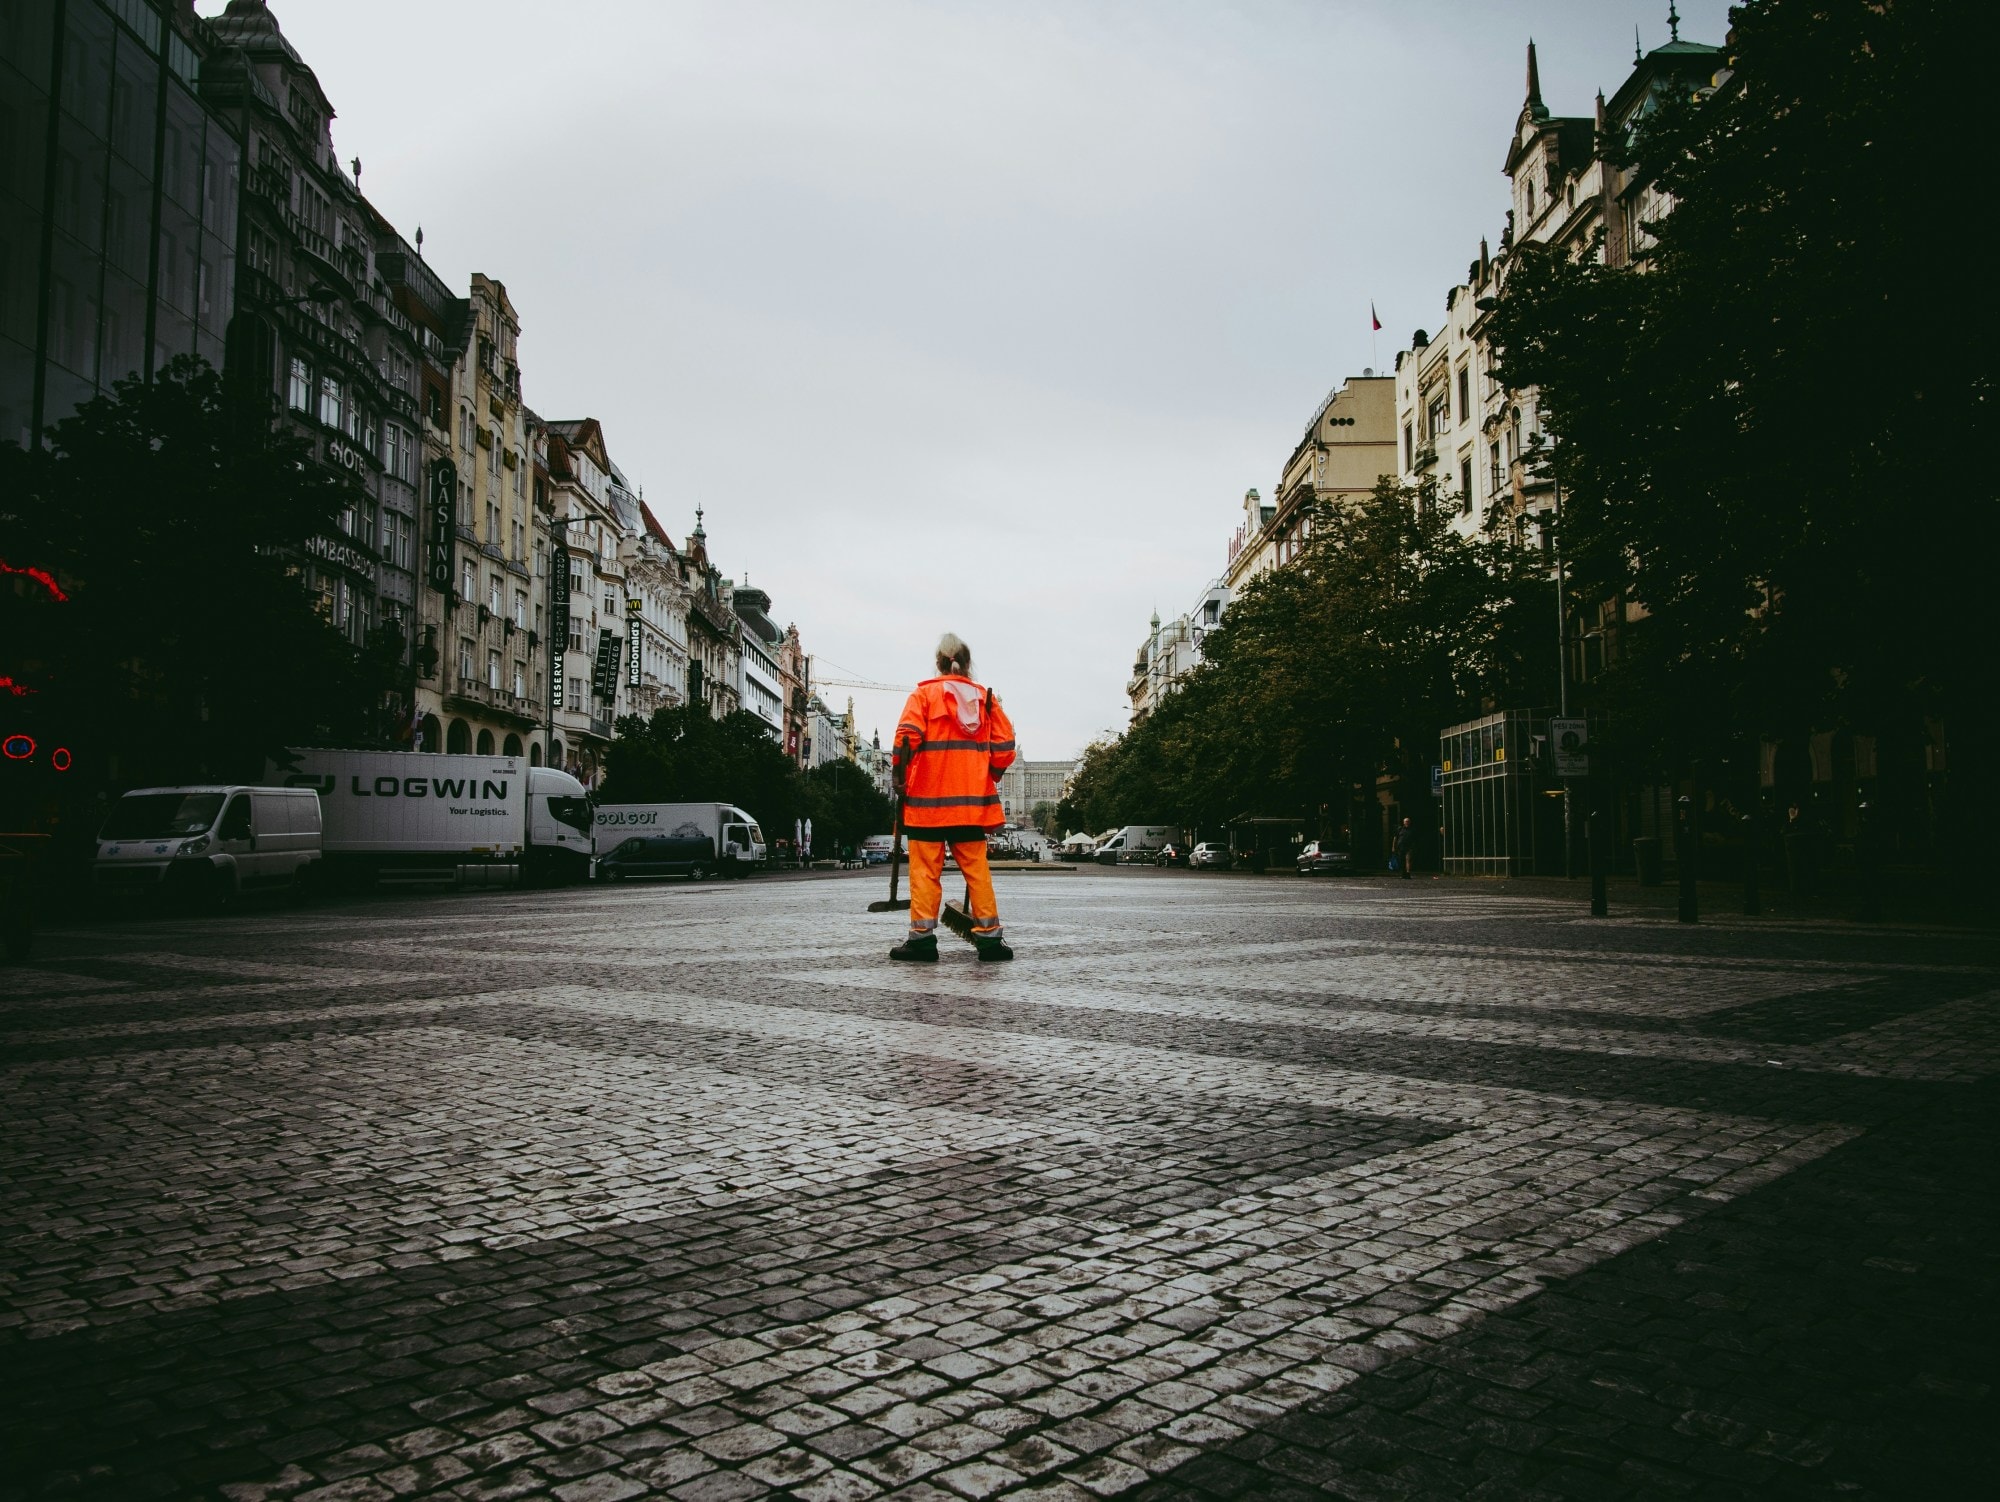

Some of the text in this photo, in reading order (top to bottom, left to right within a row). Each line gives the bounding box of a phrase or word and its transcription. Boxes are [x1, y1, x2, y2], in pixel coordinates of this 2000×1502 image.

[436, 468, 450, 581] CASINO
[556, 552, 565, 604] KONGRESOV
[607, 645, 620, 695] RESERVED
[630, 620, 640, 685] McDonald's
[553, 651, 563, 706] RESERVE
[351, 775, 508, 800] LOGWIN
[449, 807, 509, 817] Your Logistics.
[595, 811, 658, 825] GOLGOT
